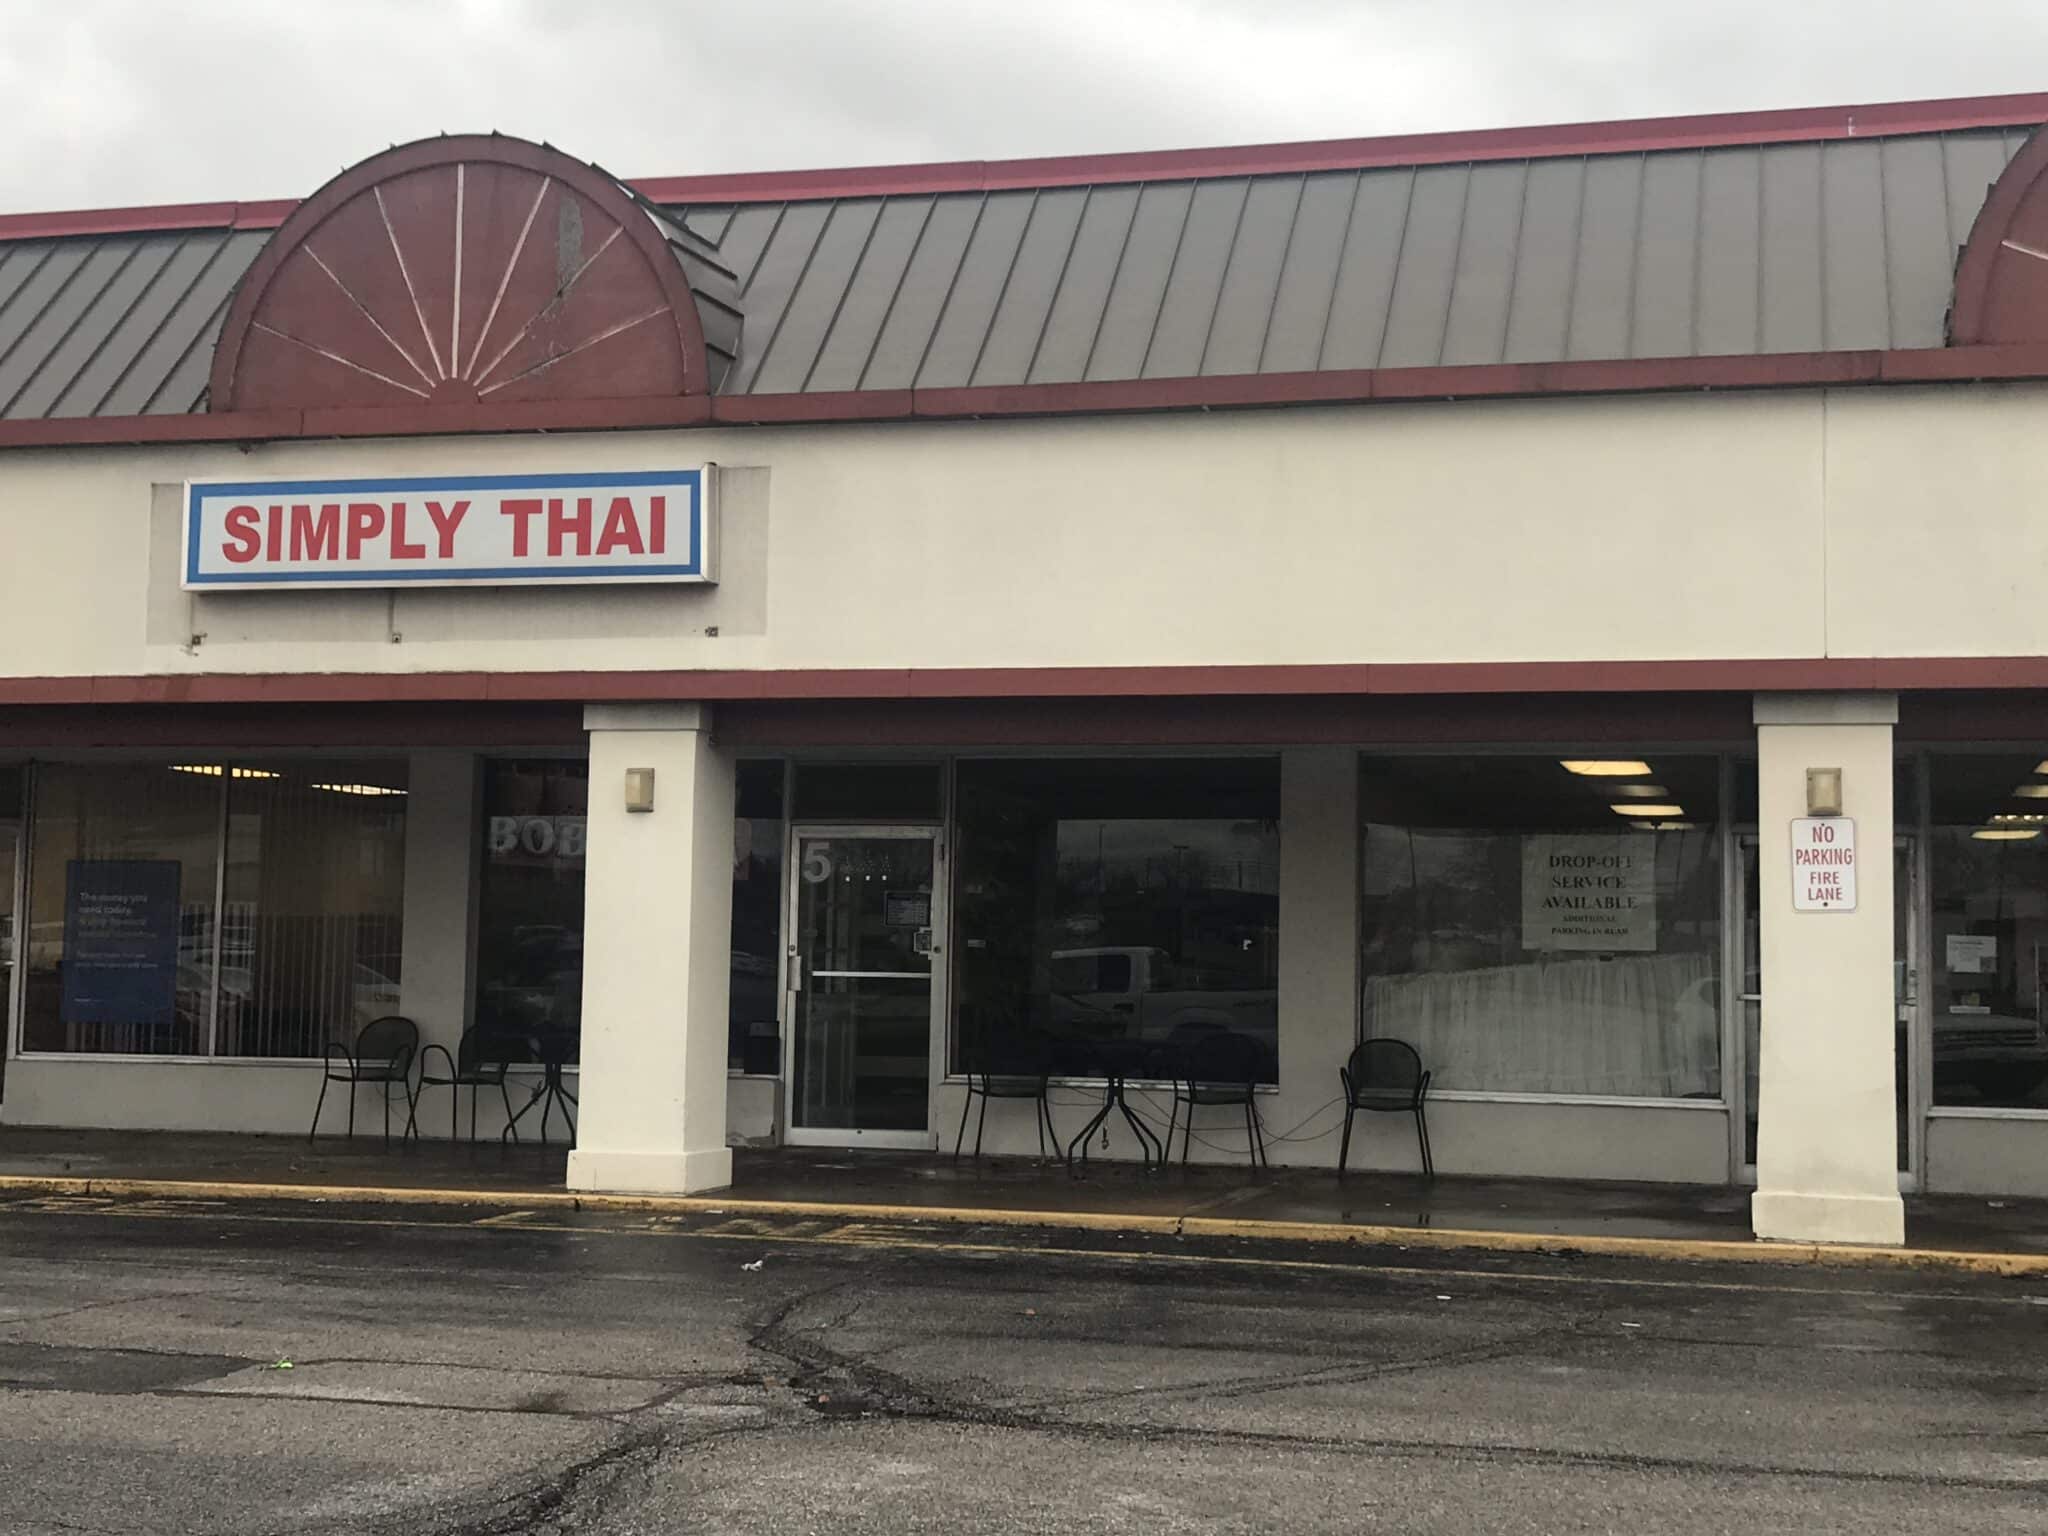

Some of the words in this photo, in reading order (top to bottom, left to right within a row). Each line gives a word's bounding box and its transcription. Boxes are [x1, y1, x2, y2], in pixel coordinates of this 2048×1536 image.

[221, 500, 472, 564] SIMPLY
[500, 495, 666, 558] THAI
[1812, 825, 1834, 843] NO
[803, 841, 831, 883] 5
[1795, 848, 1853, 865] PARKING
[1551, 875, 1626, 889] SERVICE
[1810, 871, 1840, 884] FIRE
[1808, 887, 1842, 901] LANE
[1542, 896, 1640, 909] AVAILABLE
[1551, 927, 1590, 935] PARKING
[1593, 927, 1602, 935] IN
